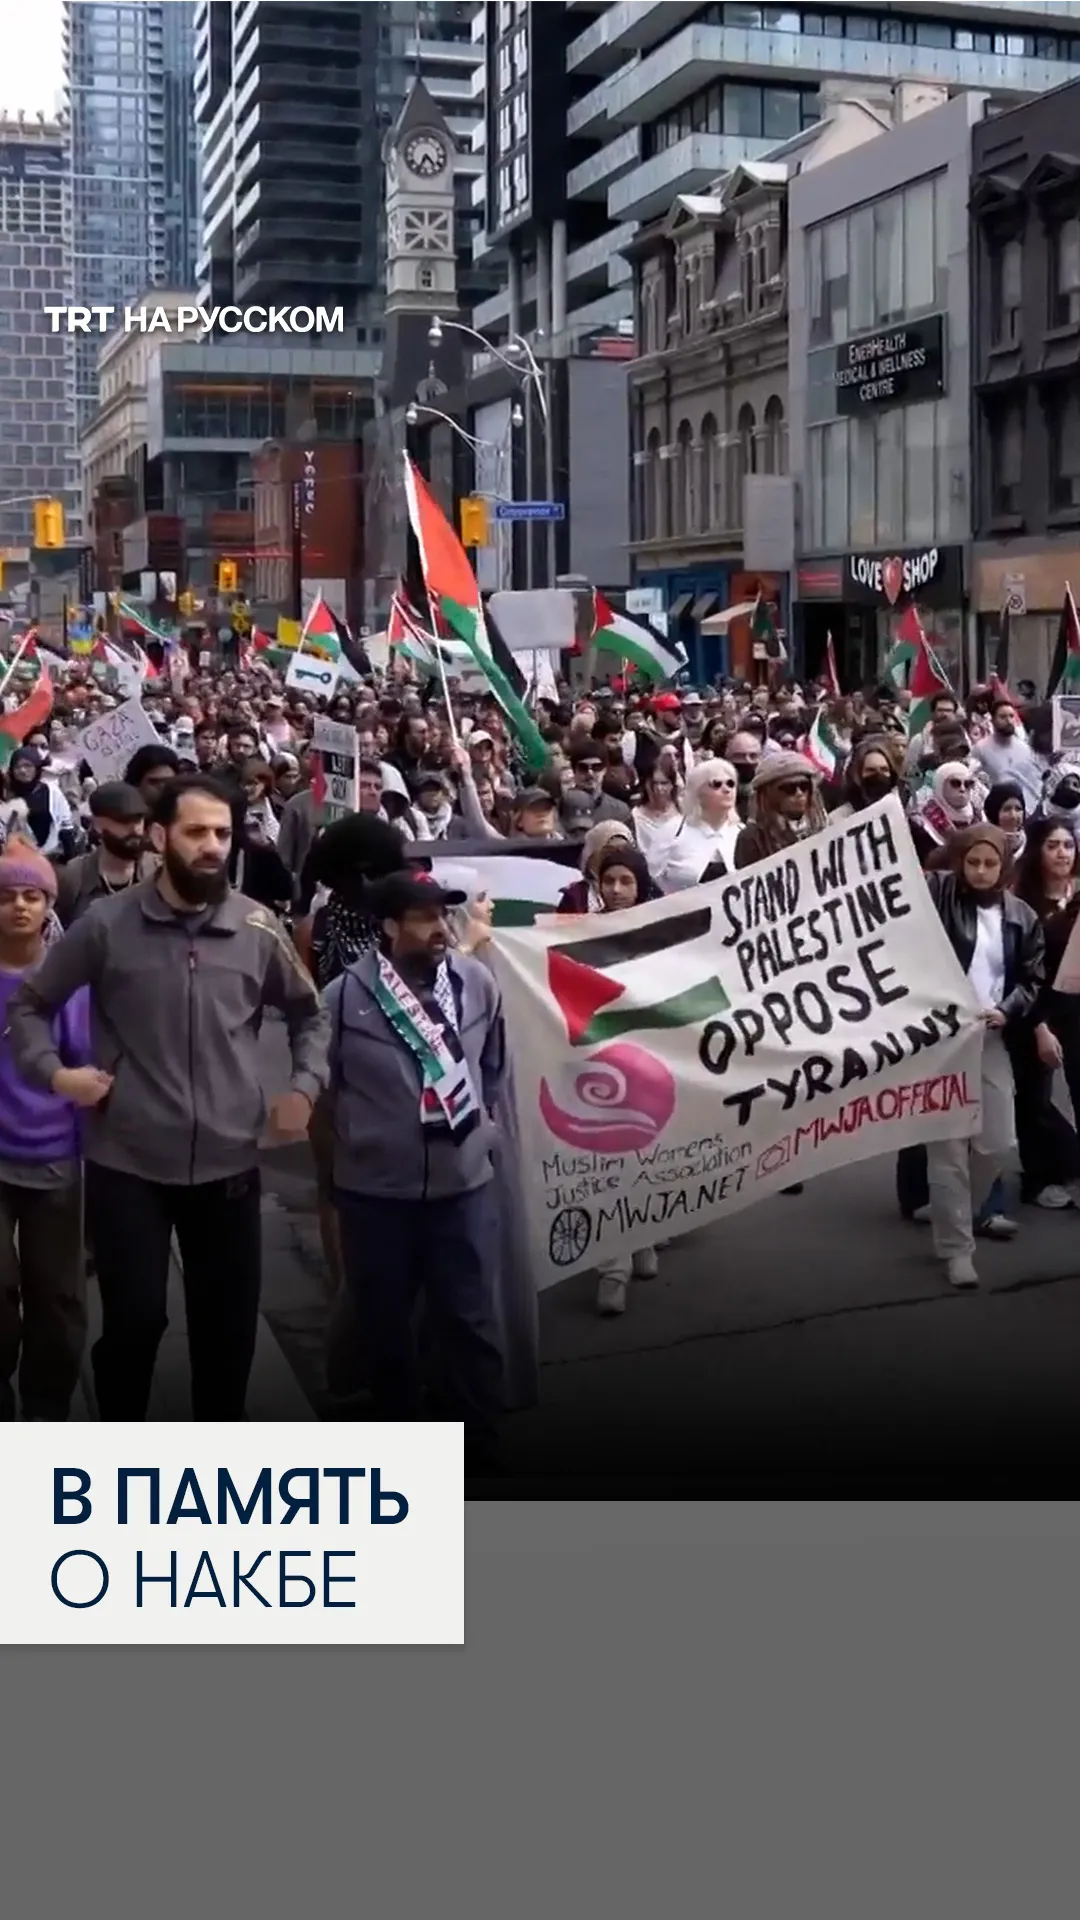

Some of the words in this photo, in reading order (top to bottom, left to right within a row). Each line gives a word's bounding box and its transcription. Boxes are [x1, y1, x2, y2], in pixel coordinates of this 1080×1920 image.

[859, 377, 895, 401] CENTRE
[879, 347, 926, 375] WELLNESS
[851, 555, 883, 592] LOVE
[903, 548, 938, 592] SHOP
[83, 711, 134, 752] GAZA
[721, 858, 800, 948] STAND
[810, 812, 898, 897] WITH
[736, 872, 912, 993] PALESTINE
[700, 939, 909, 1075] OPPOSE
[722, 1003, 961, 1127] TYRANNY
[794, 1071, 981, 1156] MWJA.OFFICIAL
[541, 1152, 625, 1184] Muslim
[546, 1175, 620, 1210] Justice
[631, 1140, 753, 1188] Association
[595, 1165, 750, 1242] MWJA.NET
